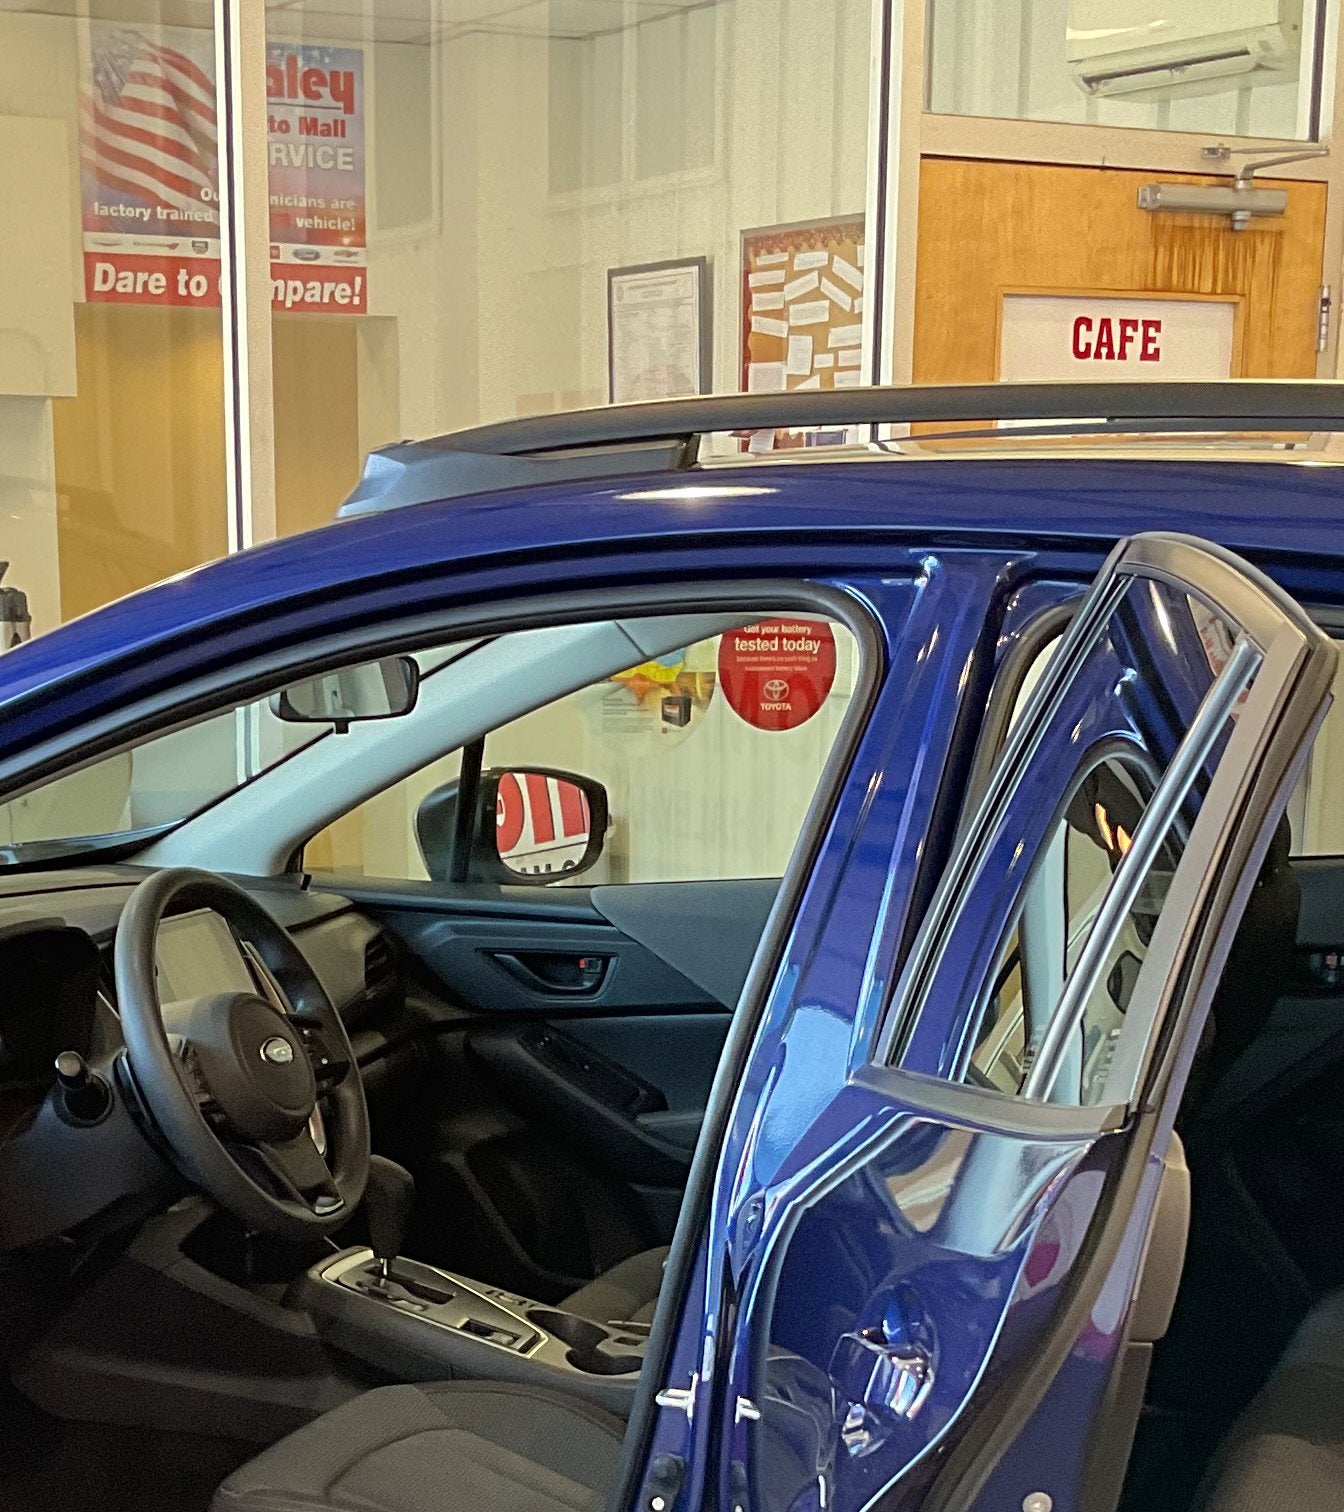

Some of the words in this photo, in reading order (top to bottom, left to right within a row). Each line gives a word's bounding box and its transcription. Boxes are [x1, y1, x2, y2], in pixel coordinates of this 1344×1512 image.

[265, 52, 355, 115] aley
[267, 114, 291, 135] to
[298, 116, 347, 138] Mall
[268, 142, 354, 171] RVICE
[269, 193, 327, 209] nicians
[330, 199, 356, 210] are
[156, 205, 213, 222] trained
[295, 215, 356, 231] vehicle!
[93, 262, 167, 295] Dare
[177, 268, 208, 297] to
[218, 275, 362, 308] mpare!
[1072, 316, 1162, 362] CAFE
[761, 626, 779, 636] your
[781, 624, 812, 636] battery
[735, 636, 779, 651] tested
[782, 637, 821, 655] today
[760, 702, 792, 711] TOYOTA
